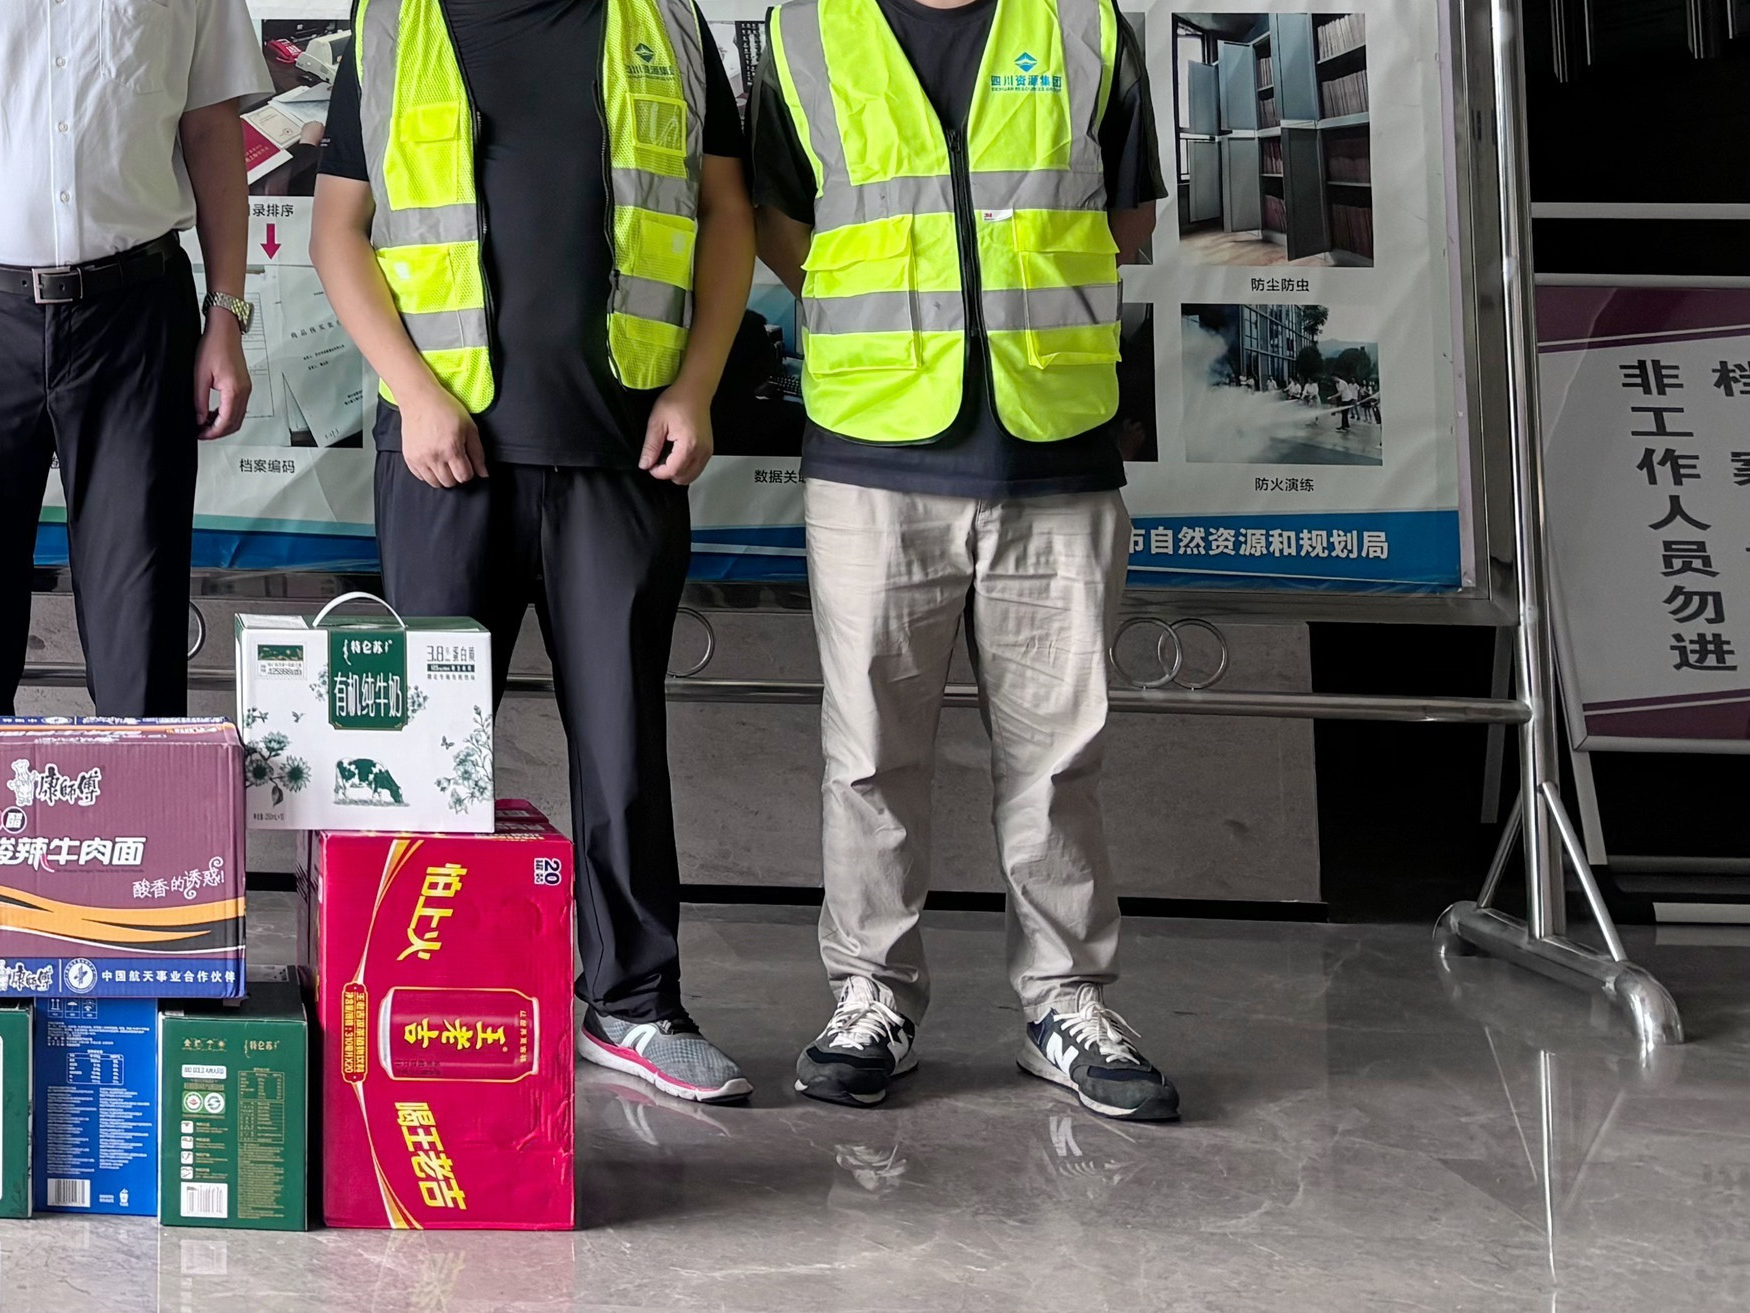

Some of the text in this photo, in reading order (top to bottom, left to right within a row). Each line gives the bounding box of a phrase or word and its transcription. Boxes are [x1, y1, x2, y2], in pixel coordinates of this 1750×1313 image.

[991, 75, 1061, 88] 四川资源集团
[248, 203, 294, 218] 录排序
[1251, 278, 1310, 292] 防尘防虫
[239, 457, 296, 474] 档案编码
[1254, 477, 1314, 492] 防火演练
[1618, 359, 1738, 672] 非工作人员勿进
[350, 639, 384, 654] 特仑苏
[334, 671, 403, 718] 有机纯牛奶
[543, 857, 561, 886] 20
[396, 862, 469, 961] 怕上火
[101, 968, 236, 984] 中国航天事业合作伙伴
[403, 1017, 506, 1051] 王老吉
[394, 1100, 468, 1212] 喝王老吉
